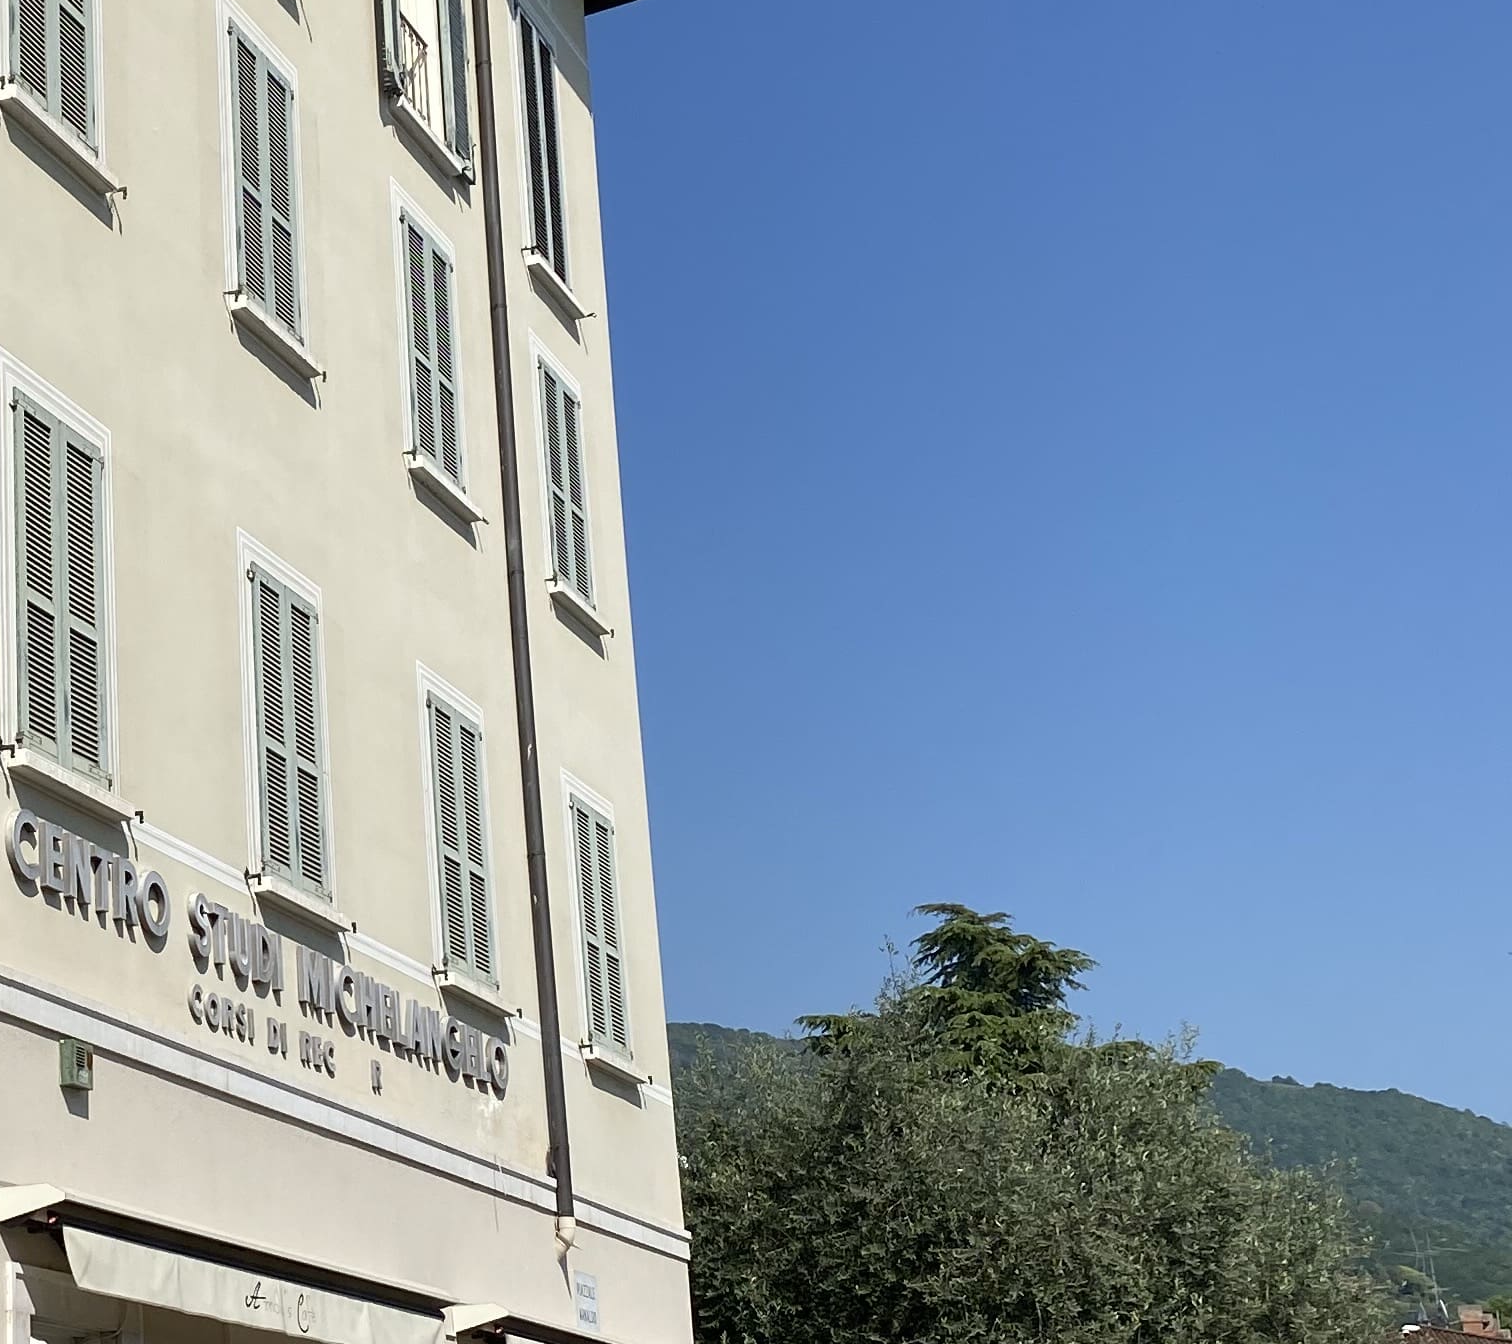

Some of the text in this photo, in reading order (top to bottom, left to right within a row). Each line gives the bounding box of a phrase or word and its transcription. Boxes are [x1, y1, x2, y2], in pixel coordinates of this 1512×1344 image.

[5, 808, 509, 1090] CENTRO STUDI MICHELANGELO
[189, 983, 254, 1042] CORSI
[267, 1017, 288, 1056] DI
